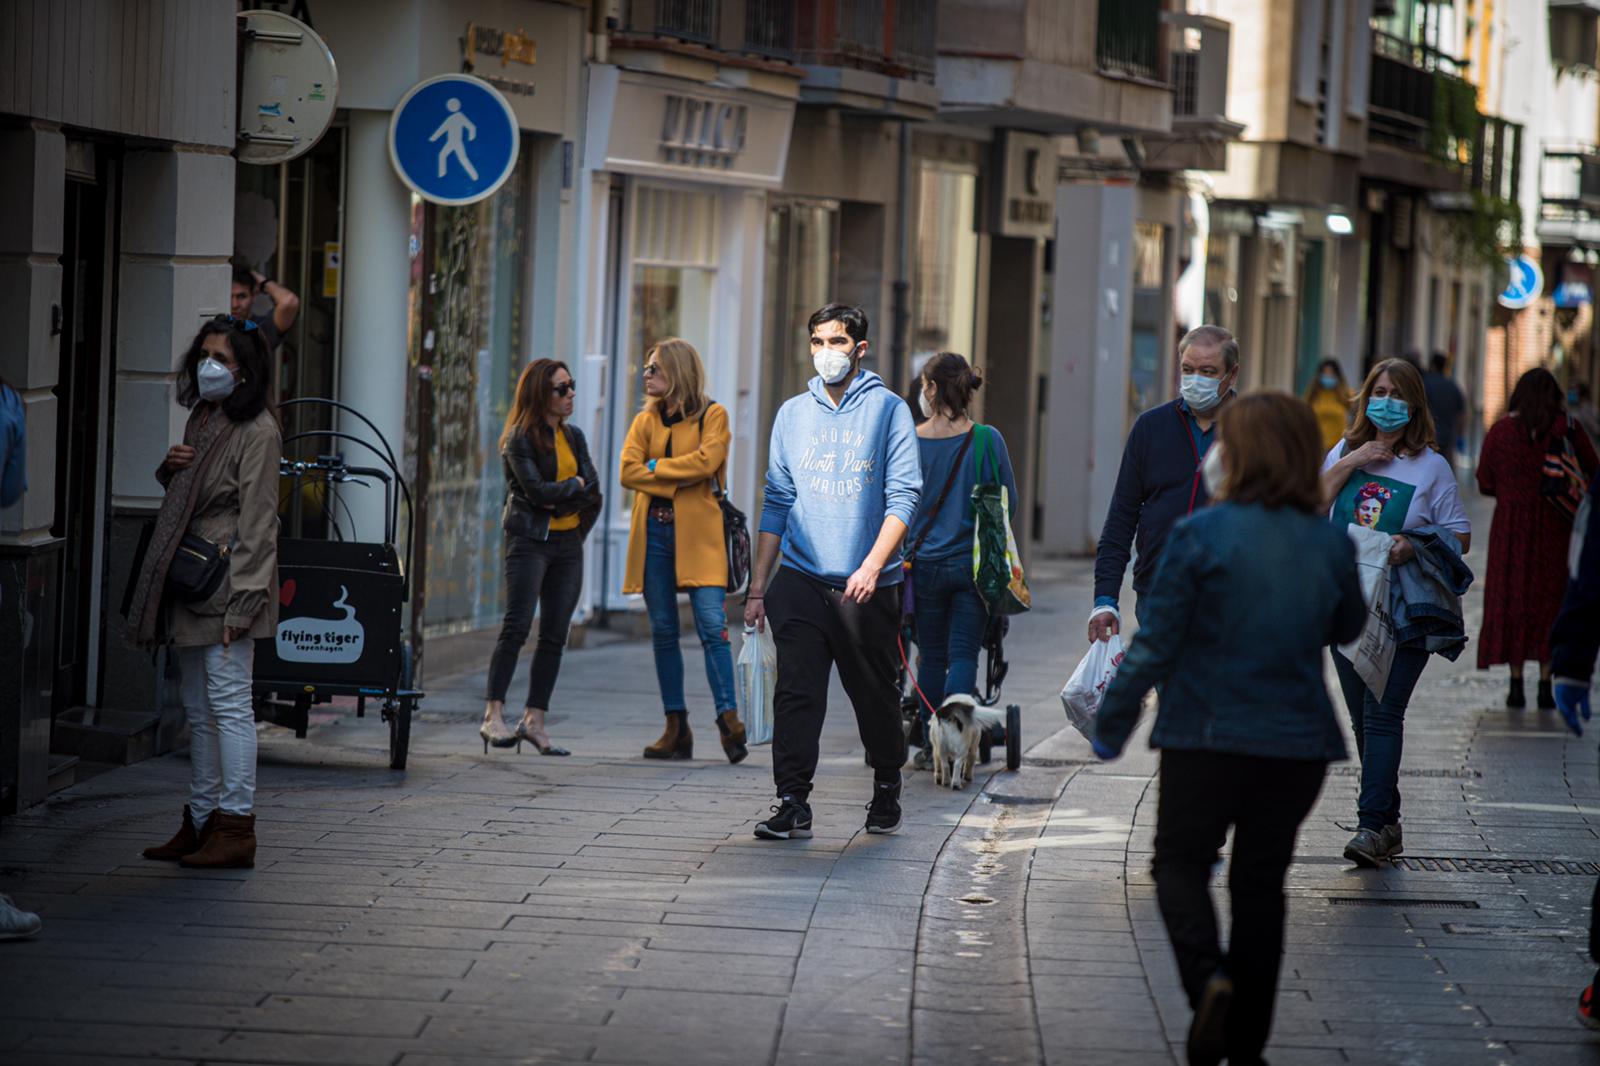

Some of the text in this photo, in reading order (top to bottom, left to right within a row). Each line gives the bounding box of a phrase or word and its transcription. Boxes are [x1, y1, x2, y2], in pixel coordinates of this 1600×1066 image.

[799, 447, 875, 473] North Park
[811, 476, 862, 496] MAJORS
[281, 630, 359, 645] flying tiger
